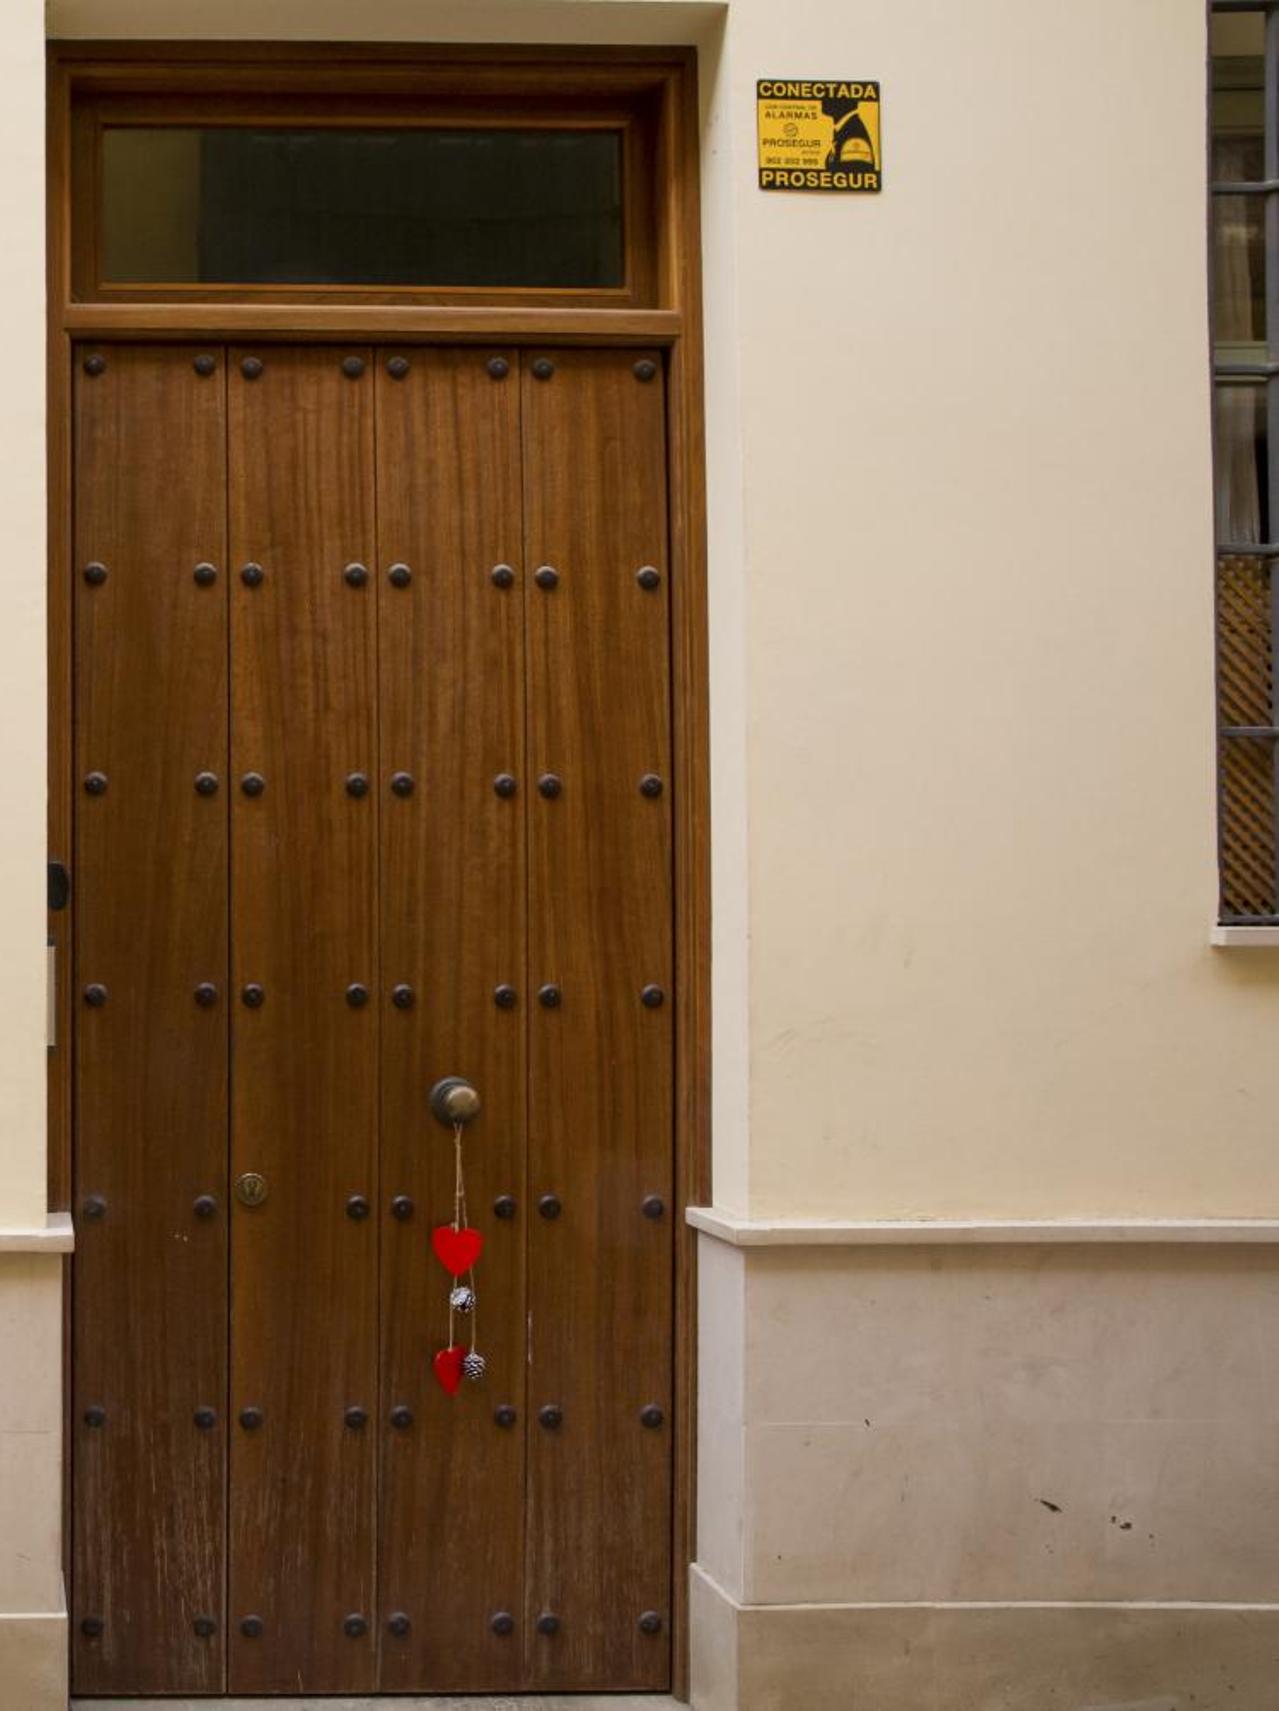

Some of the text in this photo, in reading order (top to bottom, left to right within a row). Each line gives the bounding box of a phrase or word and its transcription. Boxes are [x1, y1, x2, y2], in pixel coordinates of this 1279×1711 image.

[759, 82, 877, 99] CONECTADA
[764, 111, 818, 120] ALARMAS
[762, 138, 821, 148] PROSEGUR
[761, 171, 878, 188] PROSEGUR
